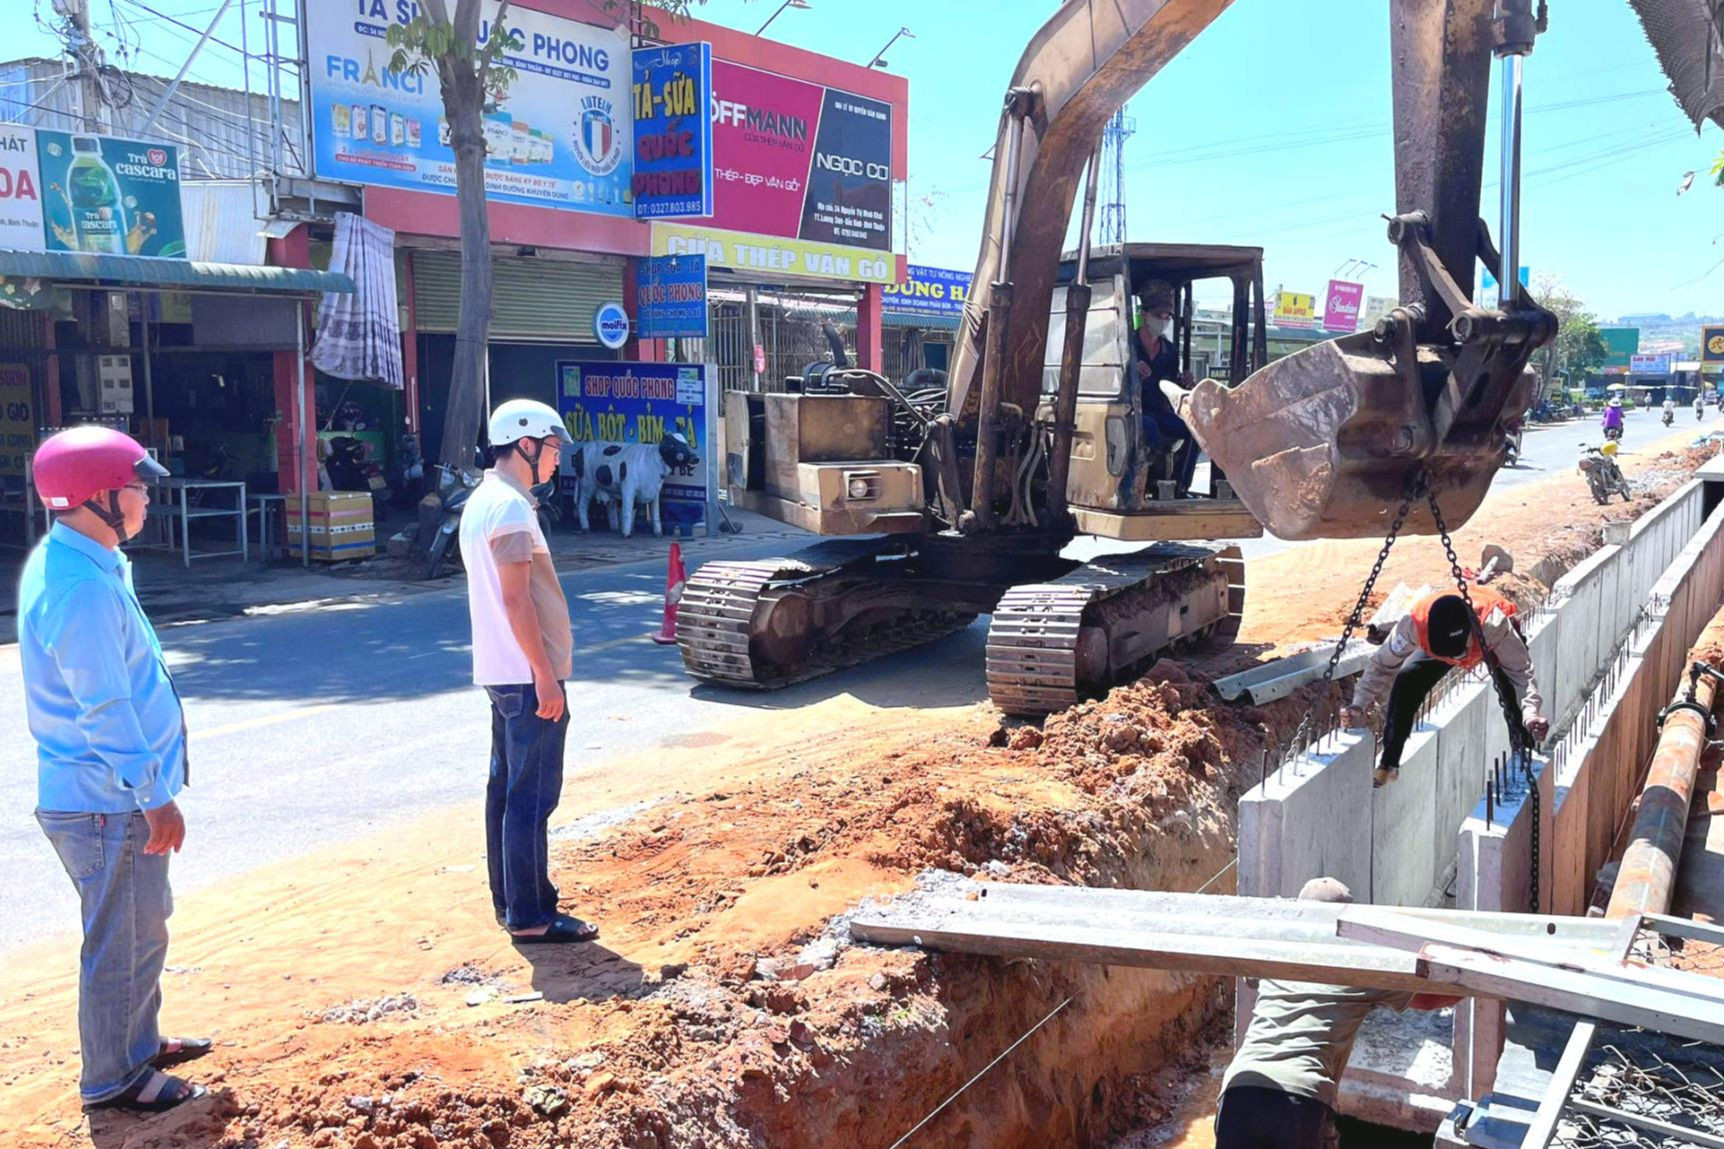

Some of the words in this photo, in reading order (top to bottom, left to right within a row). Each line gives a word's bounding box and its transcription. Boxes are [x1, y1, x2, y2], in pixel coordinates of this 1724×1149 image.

[533, 33, 609, 72] PHONG
[639, 118, 694, 161] QUỐC
[115, 163, 177, 180] cascara
[128, 153, 148, 164] Trà
[817, 152, 863, 177] NGỌC
[632, 169, 702, 198] PHONG
[651, 201, 701, 214] 0327.803.985
[734, 242, 796, 269] THÉP
[858, 254, 887, 279] GỖ
[668, 282, 702, 303] PHONG
[602, 319, 627, 330] molfix
[585, 376, 611, 396] SHOP
[612, 369, 639, 399] QUỐC
[640, 377, 675, 400] PHONG
[565, 403, 594, 440] SỮA
